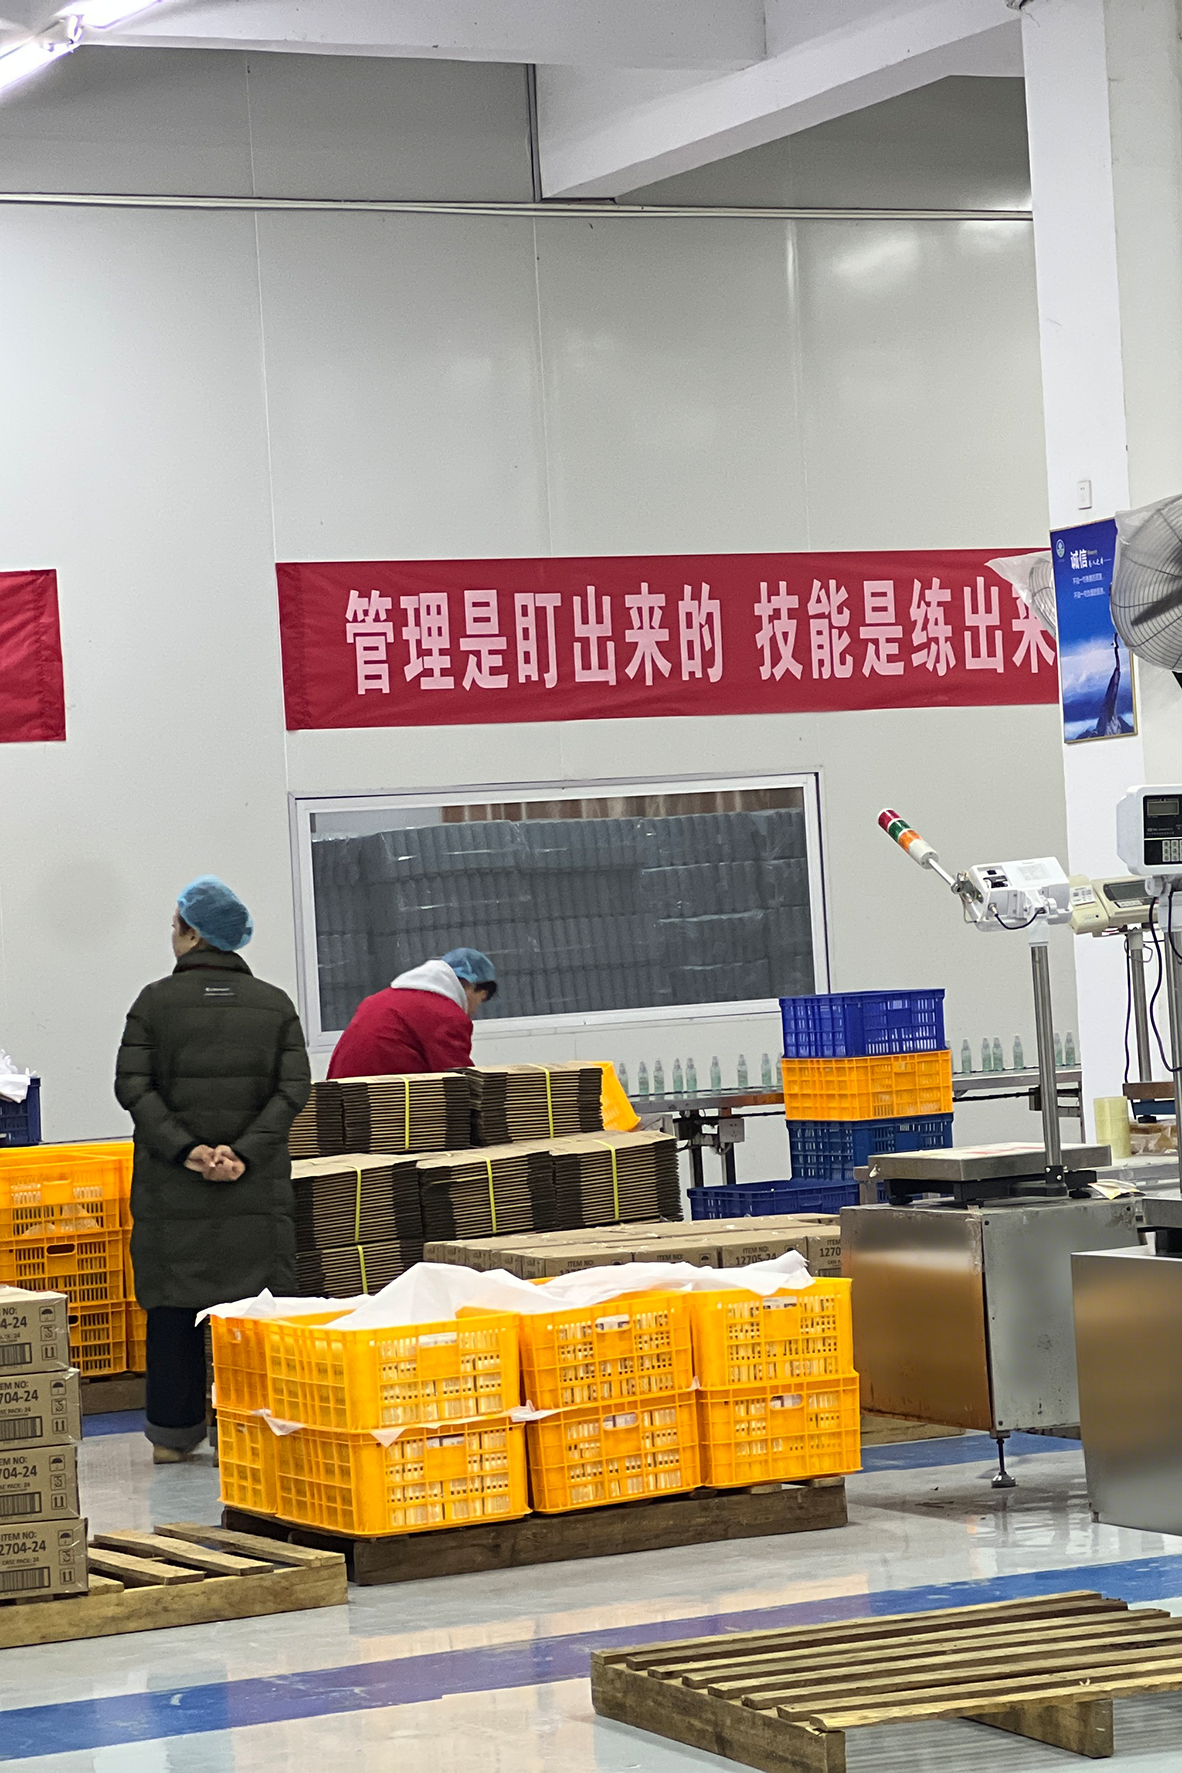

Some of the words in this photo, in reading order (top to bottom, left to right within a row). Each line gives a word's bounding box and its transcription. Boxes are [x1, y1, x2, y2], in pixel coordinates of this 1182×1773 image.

[346, 582, 723, 695] 管理是盯出来的
[820, 1247, 841, 1257] 1270
[14, 1381, 28, 1389] NO:
[13, 1456, 27, 1464] NO:
[1, 1533, 20, 1541] ITEM
[22, 1531, 37, 1539] NO:
